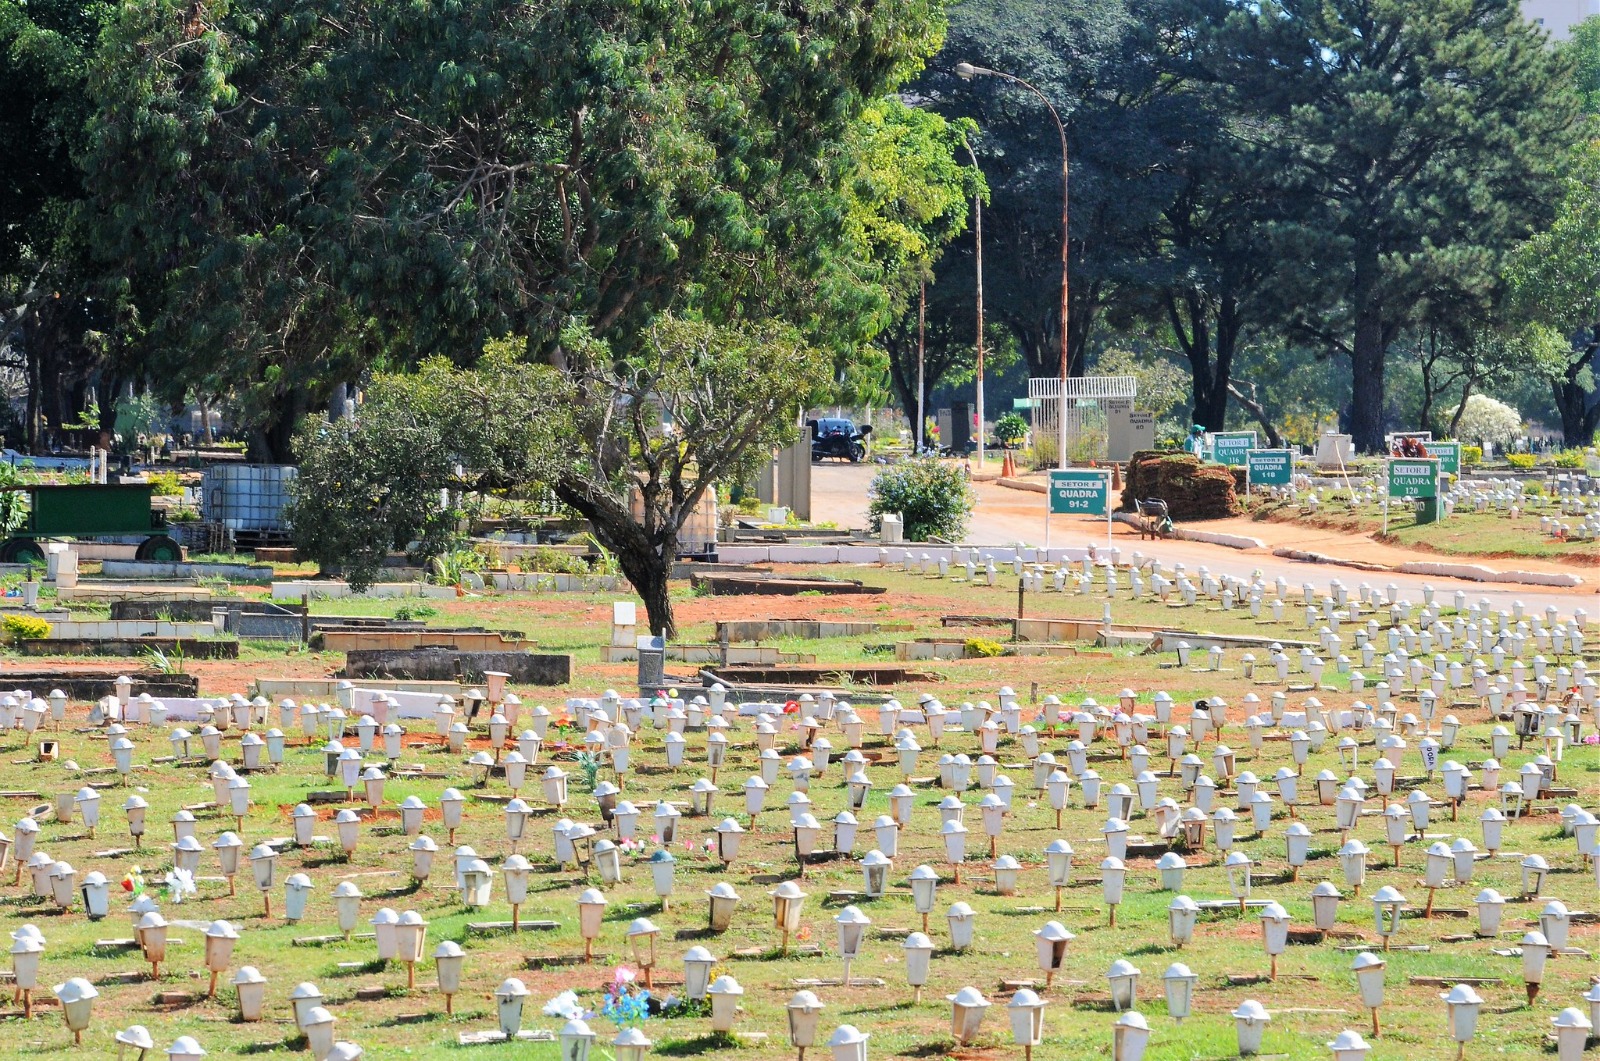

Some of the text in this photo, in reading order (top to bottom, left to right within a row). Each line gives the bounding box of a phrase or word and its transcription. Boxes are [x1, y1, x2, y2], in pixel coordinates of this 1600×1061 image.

[1218, 448, 1246, 456] QUADR
[1393, 477, 1430, 485] QUADRA
[1059, 490, 1098, 498] QUADRA
[1069, 500, 1089, 508] 91-2
